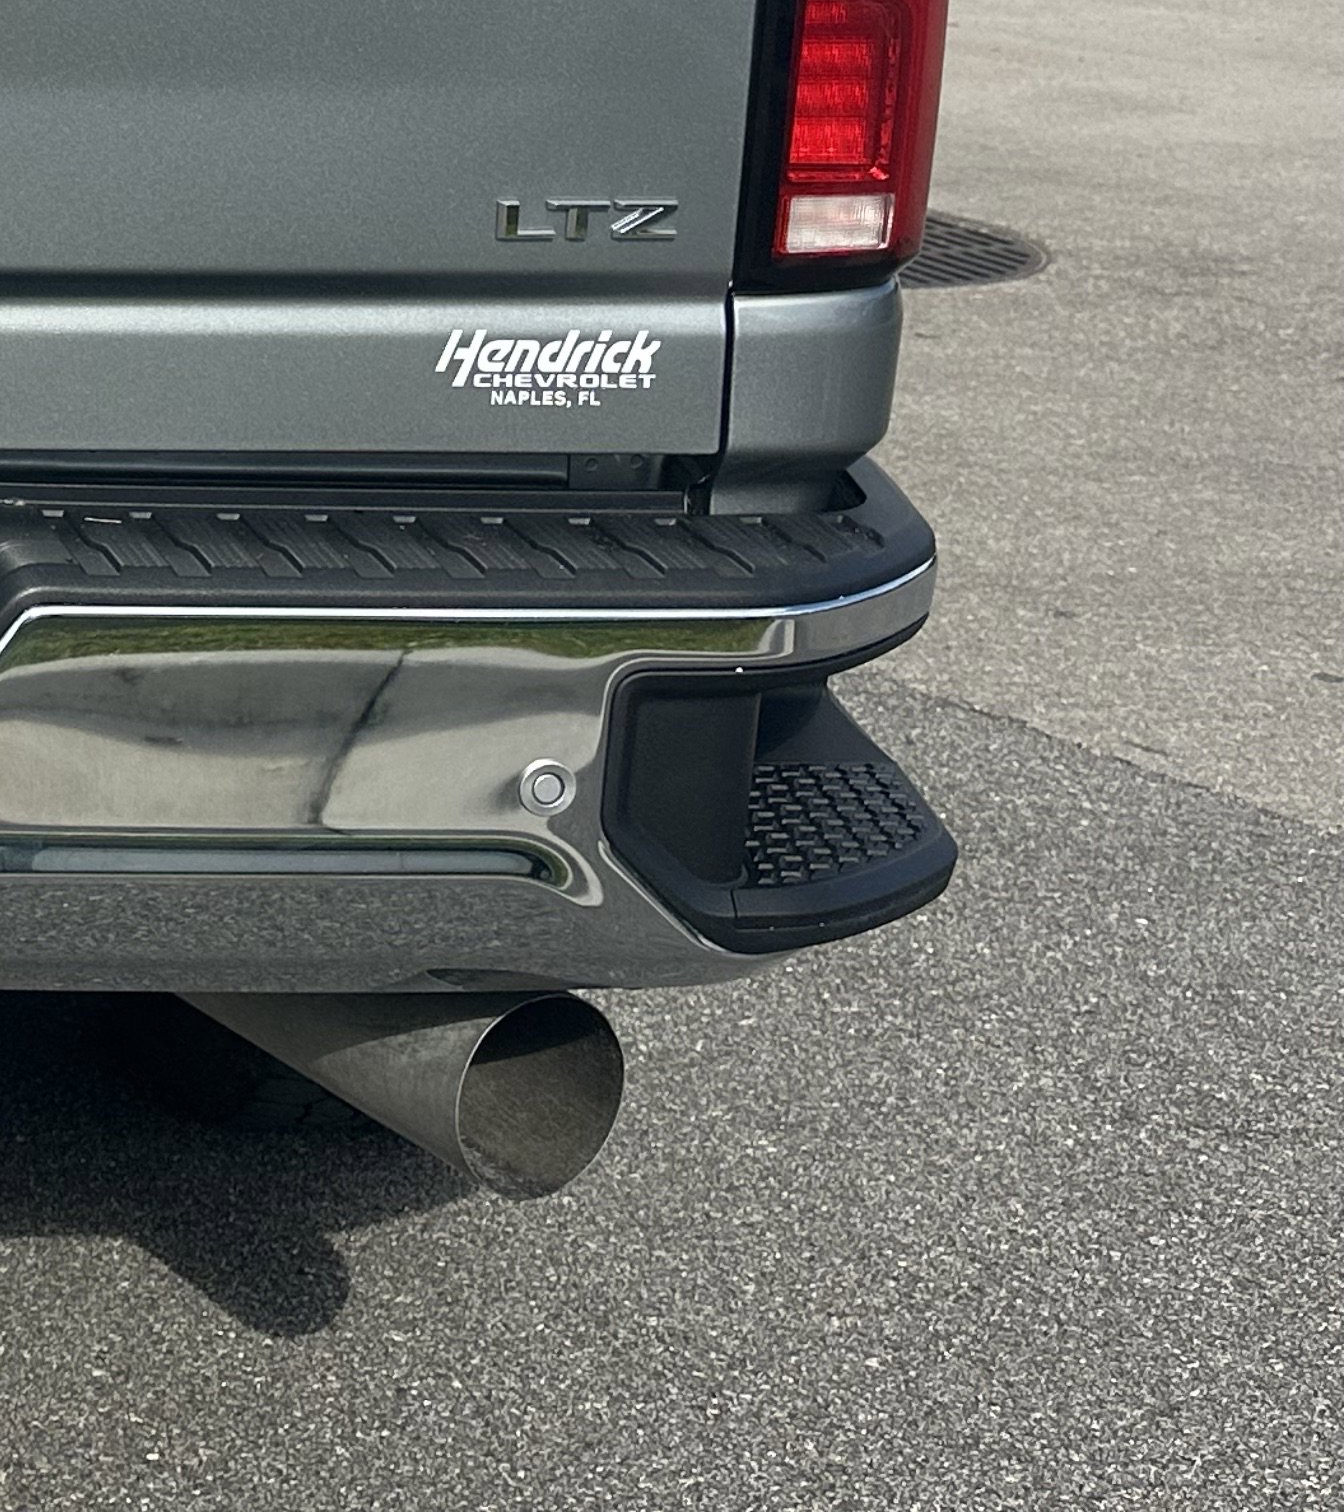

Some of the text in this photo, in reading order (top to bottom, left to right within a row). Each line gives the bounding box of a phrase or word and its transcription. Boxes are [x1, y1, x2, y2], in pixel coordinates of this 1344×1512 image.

[496, 197, 679, 241] LTZ
[435, 329, 661, 387] Hendrick
[472, 372, 656, 389] CHEVROLET
[490, 390, 600, 408] NAPLES, FL
